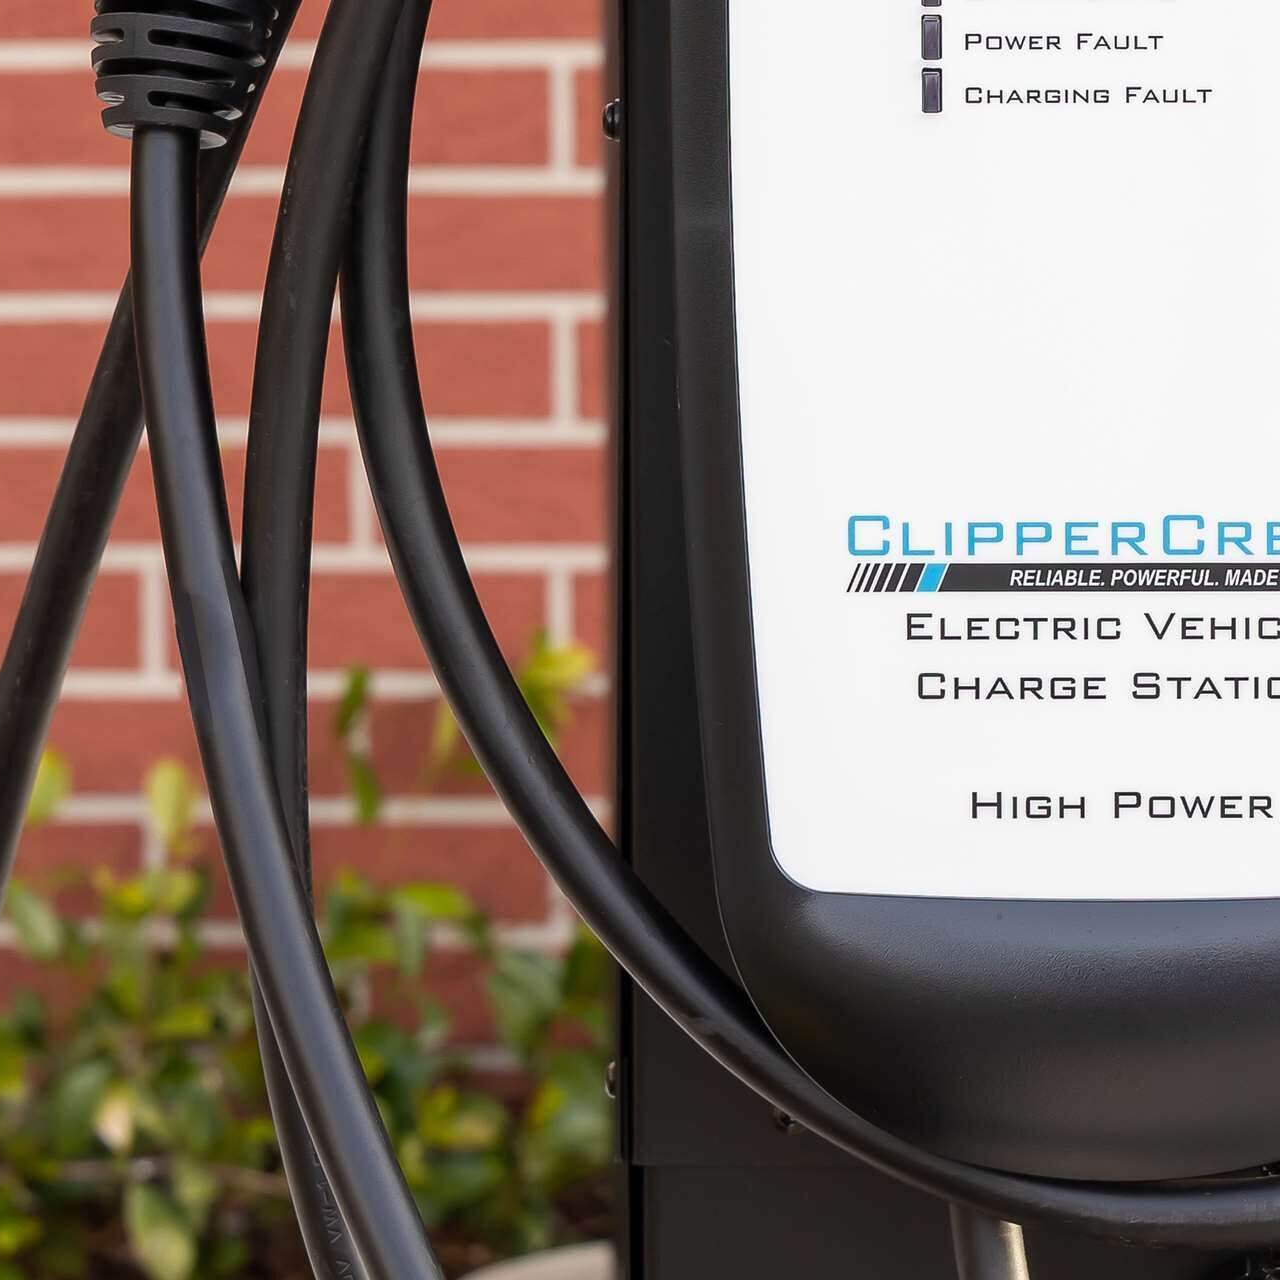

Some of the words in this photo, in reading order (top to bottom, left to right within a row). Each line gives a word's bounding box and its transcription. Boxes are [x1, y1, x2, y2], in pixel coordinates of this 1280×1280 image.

[965, 33, 1061, 50] POWER
[1077, 33, 1164, 50] FAULT
[965, 87, 1110, 104] CHARGING
[1125, 87, 1213, 104] FAULT
[1009, 569, 1105, 587] RELIABLE.
[1110, 569, 1219, 587] POWERFUL.
[1224, 569, 1279, 587] MADE
[906, 613, 1121, 640] ELECTRIC
[918, 673, 1107, 700] CHARGE
[972, 792, 1085, 819] HIGH
[1114, 792, 1273, 819] POWER
